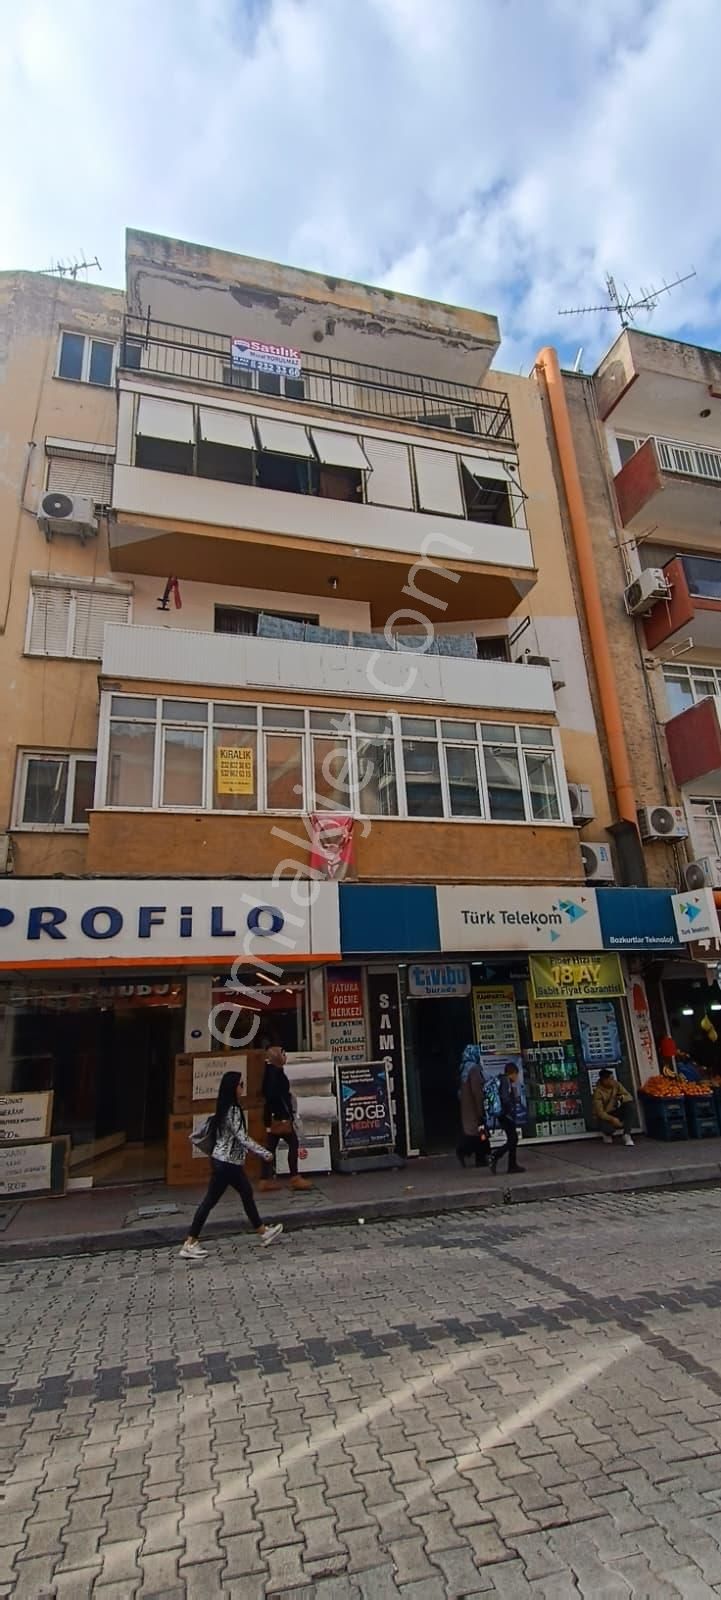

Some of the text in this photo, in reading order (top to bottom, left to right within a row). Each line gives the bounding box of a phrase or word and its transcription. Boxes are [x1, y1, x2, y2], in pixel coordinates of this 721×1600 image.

[251, 342, 299, 358] Satılık
[461, 910, 562, 925] Türk Telekom
[610, 936, 674, 945] Bozkurtlar Teknoloji
[412, 966, 466, 986] tivibu
[552, 964, 601, 984] 18 AY
[346, 1104, 385, 1121] 50 GB
